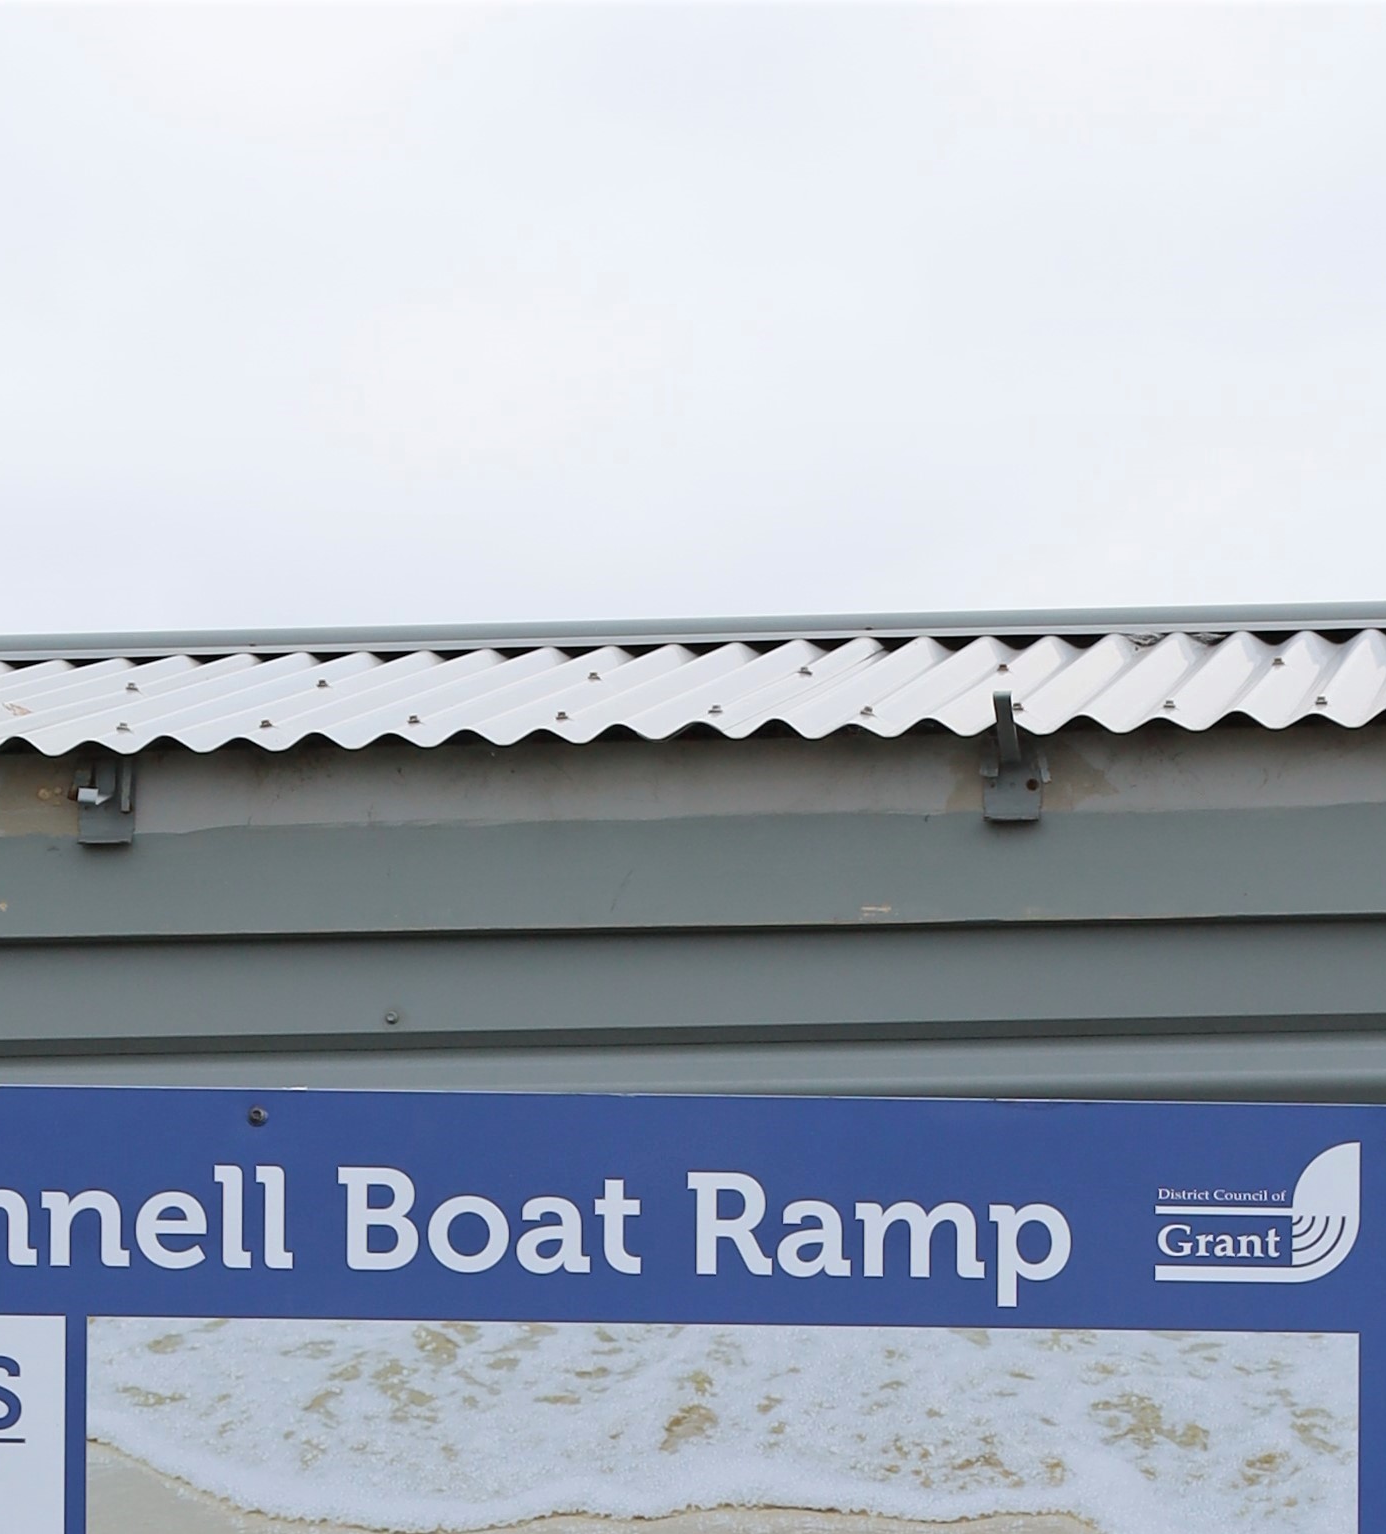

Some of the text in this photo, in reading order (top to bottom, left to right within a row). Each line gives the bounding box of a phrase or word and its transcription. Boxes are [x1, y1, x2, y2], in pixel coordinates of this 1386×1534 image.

[1159, 1189, 1287, 1202] District Council of
[338, 1167, 641, 1274] Boat
[688, 1172, 1070, 1307] Ramp
[1158, 1225, 1280, 1257] Grant
